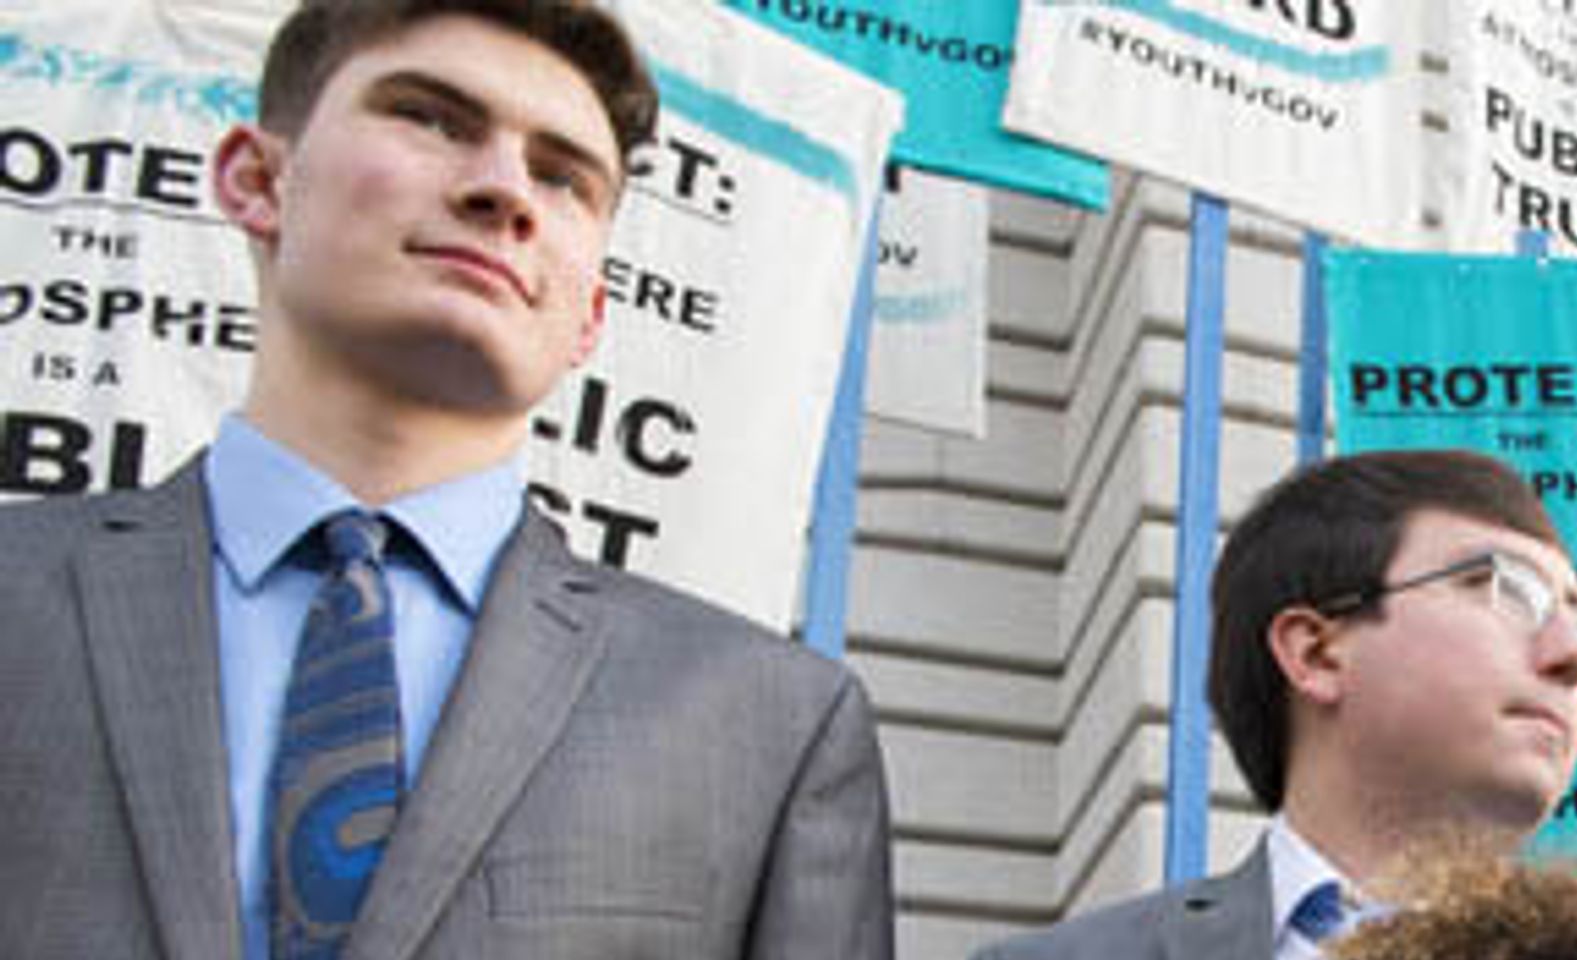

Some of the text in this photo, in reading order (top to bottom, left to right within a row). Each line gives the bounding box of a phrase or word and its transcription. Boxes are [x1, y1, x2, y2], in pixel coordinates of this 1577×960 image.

[53, 226, 138, 258] THE
[33, 352, 121, 386] IS A
[1497, 431, 1548, 452] THE
